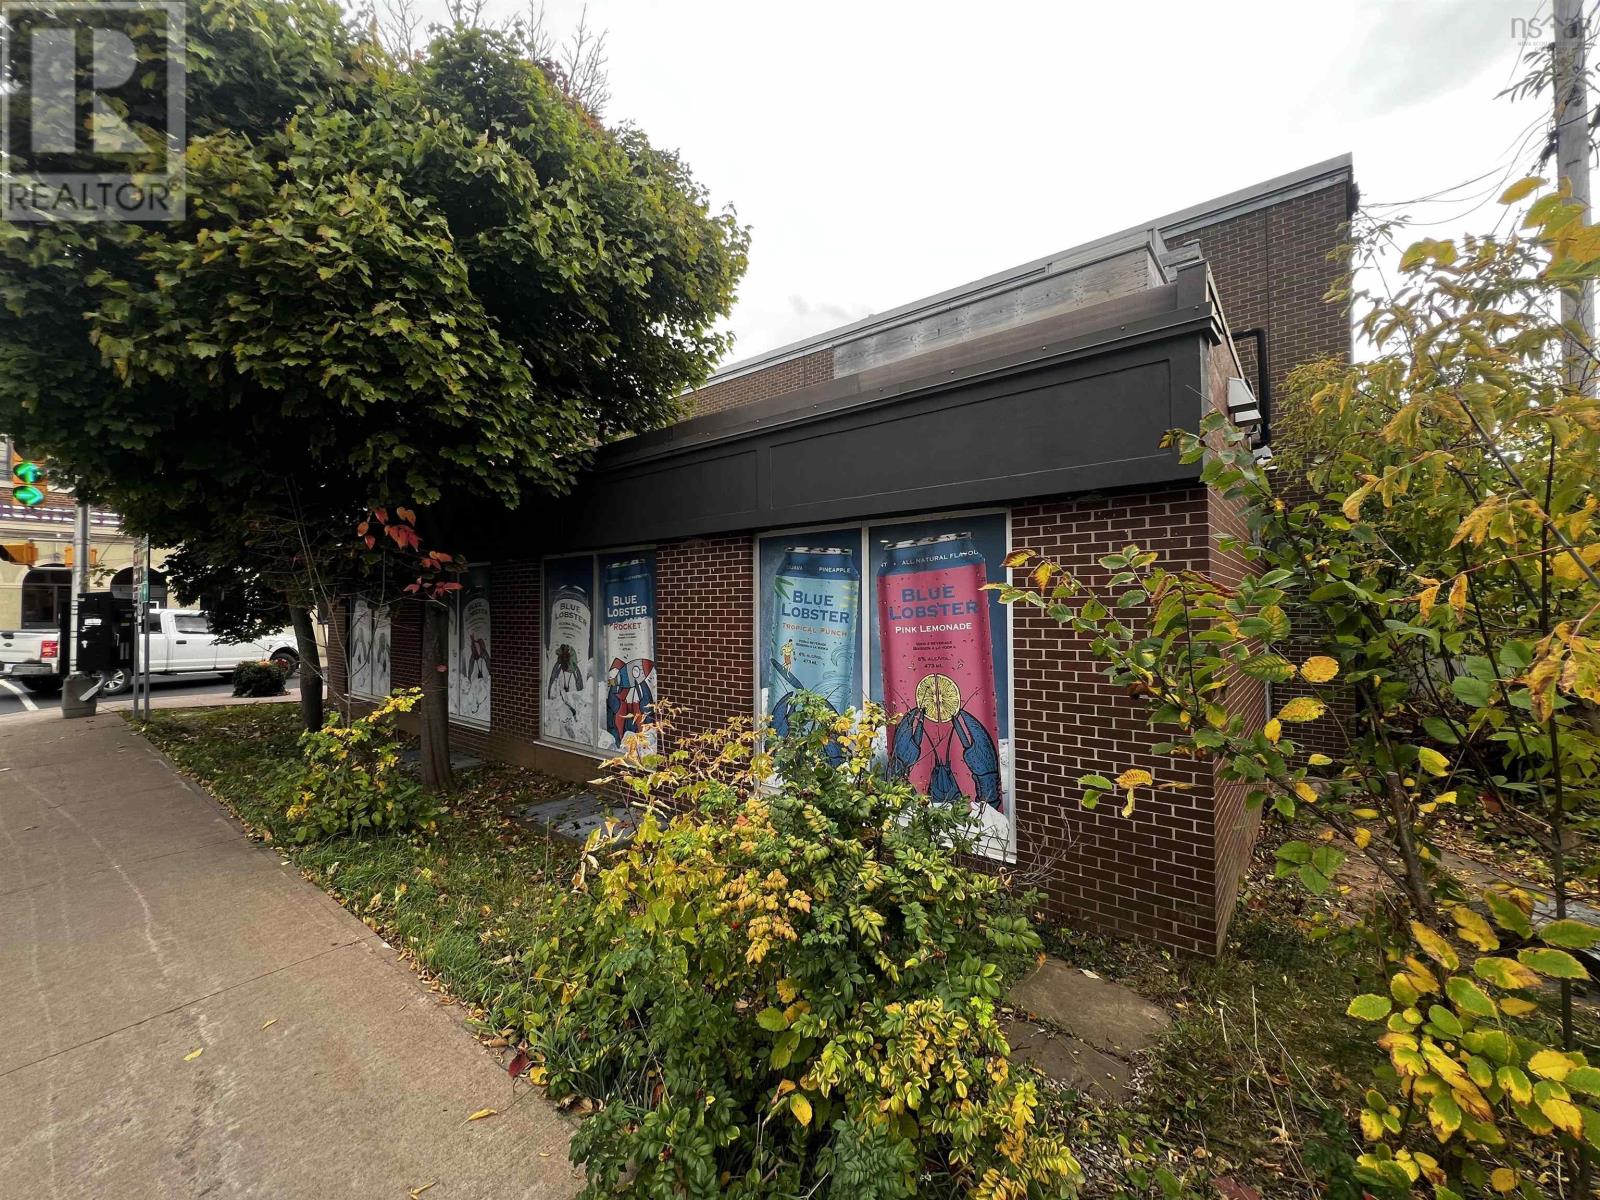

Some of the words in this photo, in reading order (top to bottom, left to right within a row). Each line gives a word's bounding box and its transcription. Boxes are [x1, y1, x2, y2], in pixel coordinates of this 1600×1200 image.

[915, 554, 949, 564] NATURAL
[612, 595, 637, 606] BLUE
[793, 590, 834, 607] BLUE
[901, 585, 955, 602] BLUE
[560, 602, 581, 613] BLUE
[607, 605, 648, 618] LOBSTER
[781, 602, 850, 624] LOBSTER
[888, 600, 979, 620] LOBSTER
[555, 611, 587, 627] LOBSTER
[613, 622, 642, 631] ROCKET
[782, 622, 817, 634] TROPICAL
[820, 627, 848, 637] PUNCH
[895, 626, 917, 634] PINK
[920, 622, 972, 633] LEMONADE
